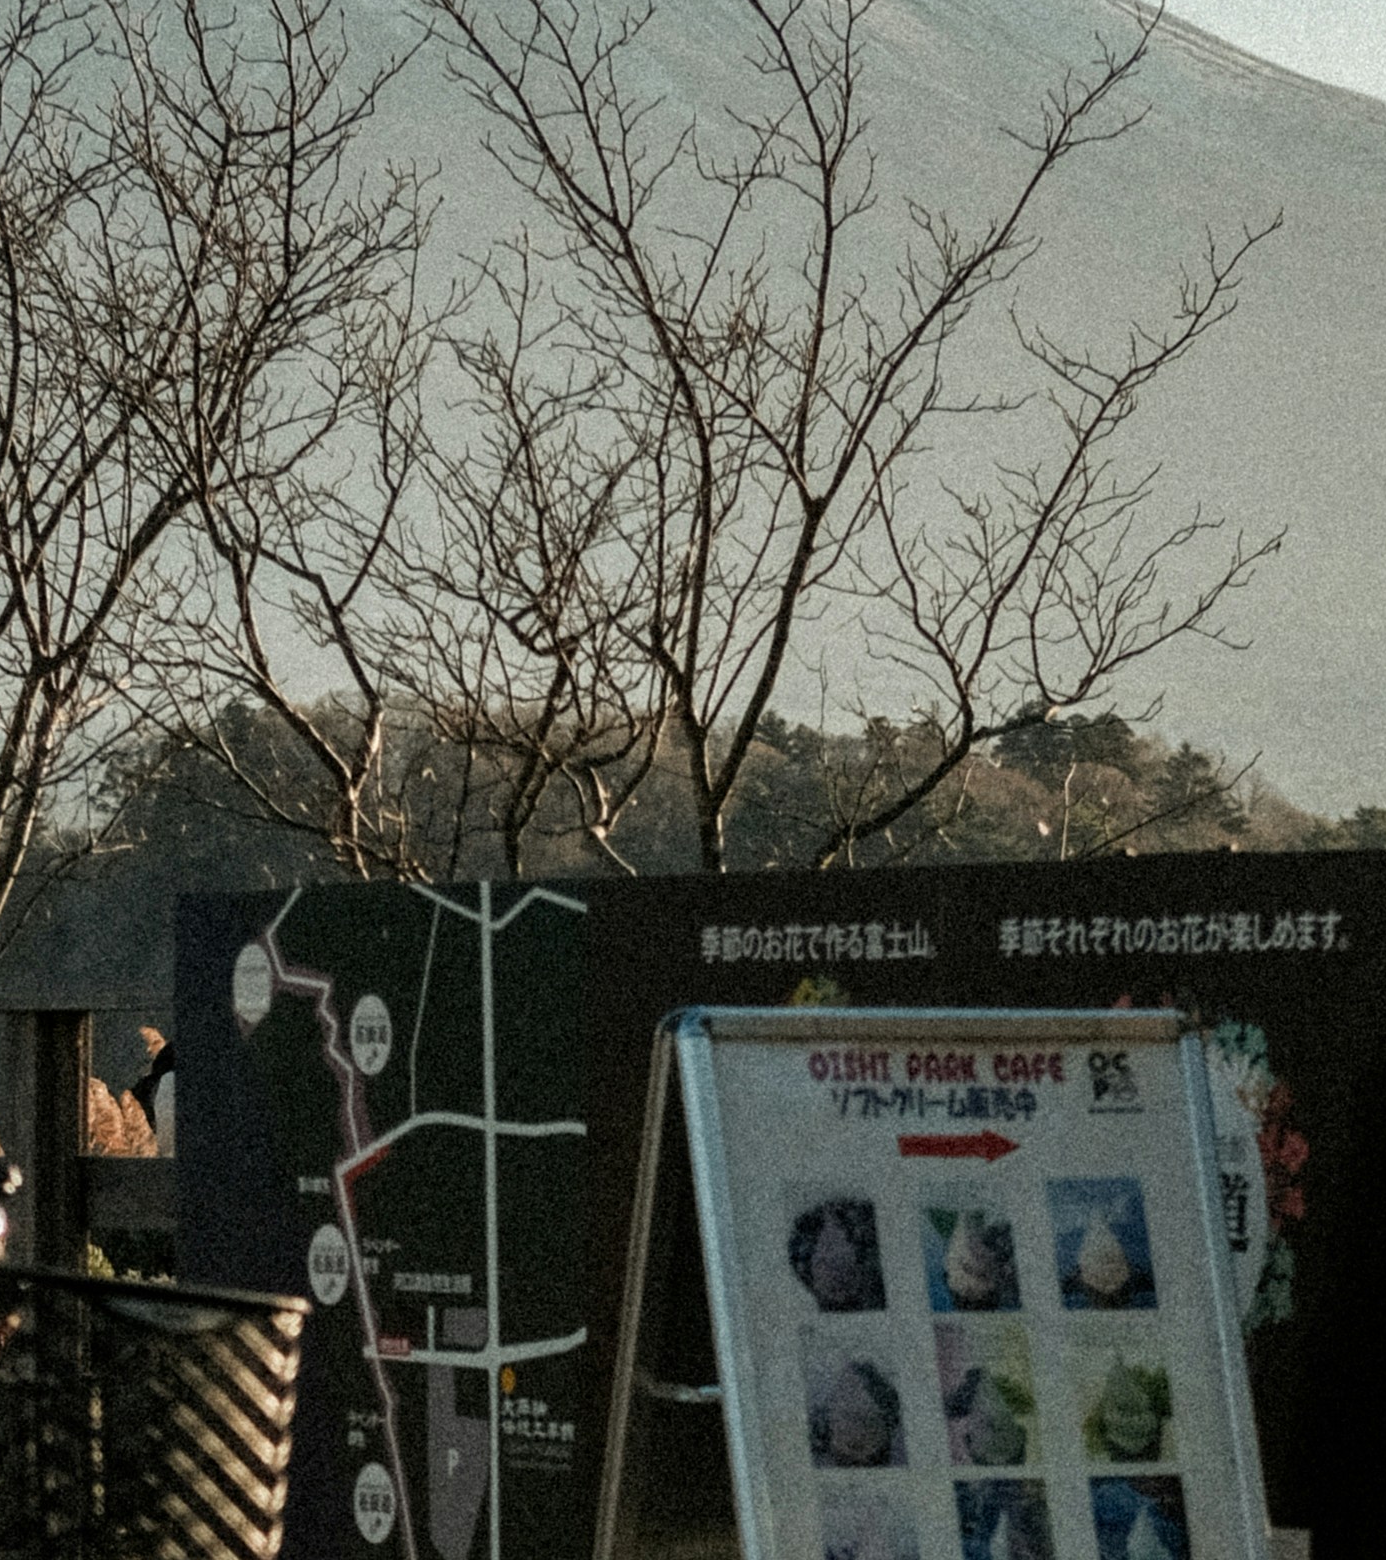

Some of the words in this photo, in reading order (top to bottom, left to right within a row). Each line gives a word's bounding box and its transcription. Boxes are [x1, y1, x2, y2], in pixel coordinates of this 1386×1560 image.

[999, 910, 1349, 958] 季節それぞれのお花が楽しめます。
[808, 1051, 891, 1083] OISHI
[907, 1052, 977, 1083] PARK
[994, 1052, 1065, 1083] CAFE
[830, 1087, 1038, 1121] ソフトクリーム販売中
